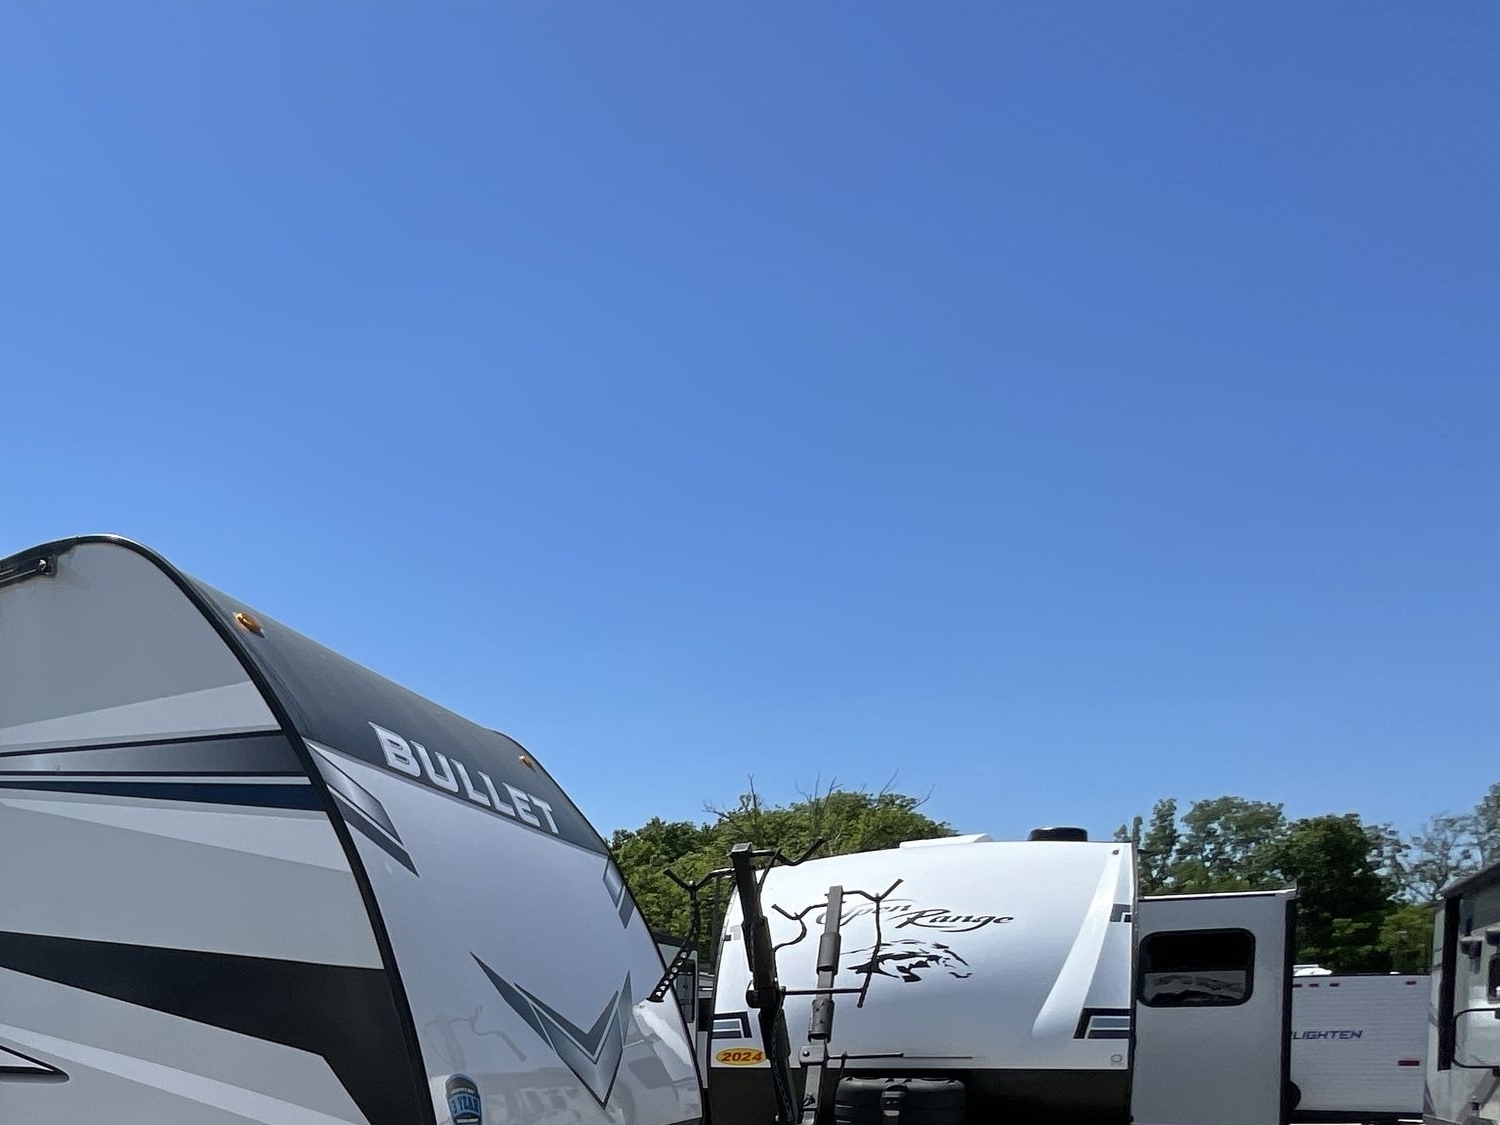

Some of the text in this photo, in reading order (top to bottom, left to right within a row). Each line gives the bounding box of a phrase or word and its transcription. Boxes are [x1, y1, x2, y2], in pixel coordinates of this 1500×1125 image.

[368, 721, 560, 835] BULLET
[886, 908, 1015, 933] Range
[1290, 1029, 1364, 1040] LIGHTEN
[721, 1051, 764, 1062] 2024
